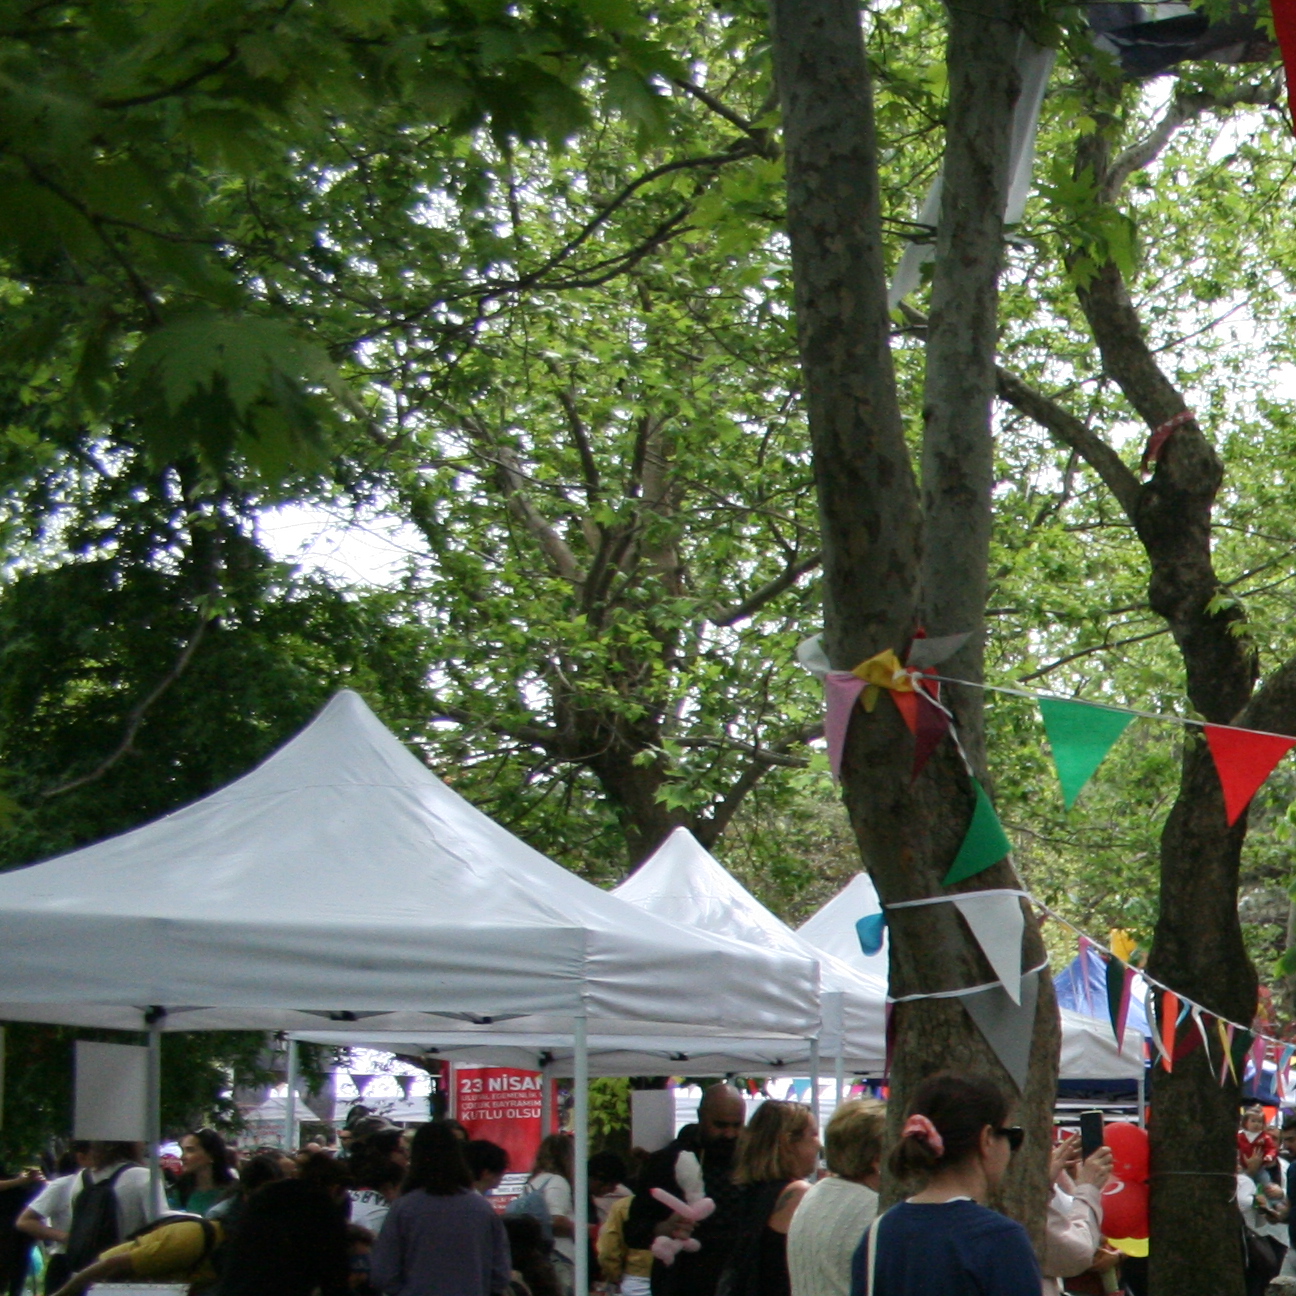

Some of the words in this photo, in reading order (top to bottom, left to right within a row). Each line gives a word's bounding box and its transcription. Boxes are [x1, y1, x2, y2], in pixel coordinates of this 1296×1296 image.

[461, 1078, 483, 1093] 23
[461, 1109, 502, 1121] KUTLU
[506, 1108, 541, 1119] OLSU
